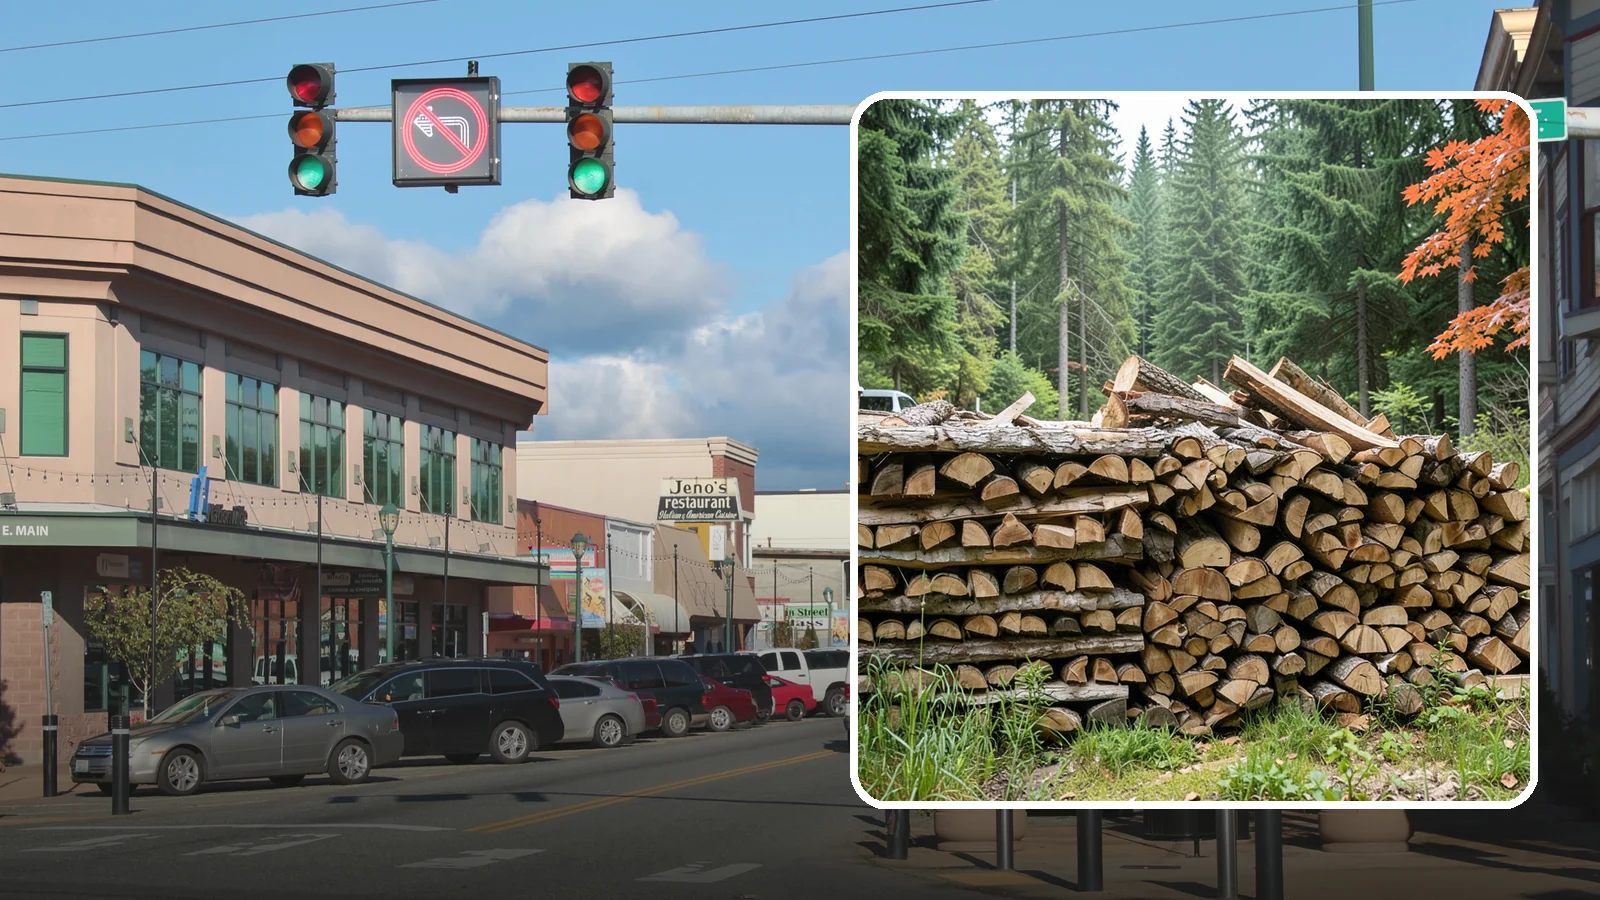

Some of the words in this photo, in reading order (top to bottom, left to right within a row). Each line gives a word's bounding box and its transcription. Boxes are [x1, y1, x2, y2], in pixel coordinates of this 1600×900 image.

[670, 480, 727, 494] Jeno's
[665, 496, 731, 509] restaurant
[659, 510, 682, 520] Italian
[686, 510, 715, 519] American
[715, 510, 737, 519] Cuisine
[2, 525, 13, 536] E.
[15, 525, 49, 536] MAIN
[791, 619, 824, 627] lass
